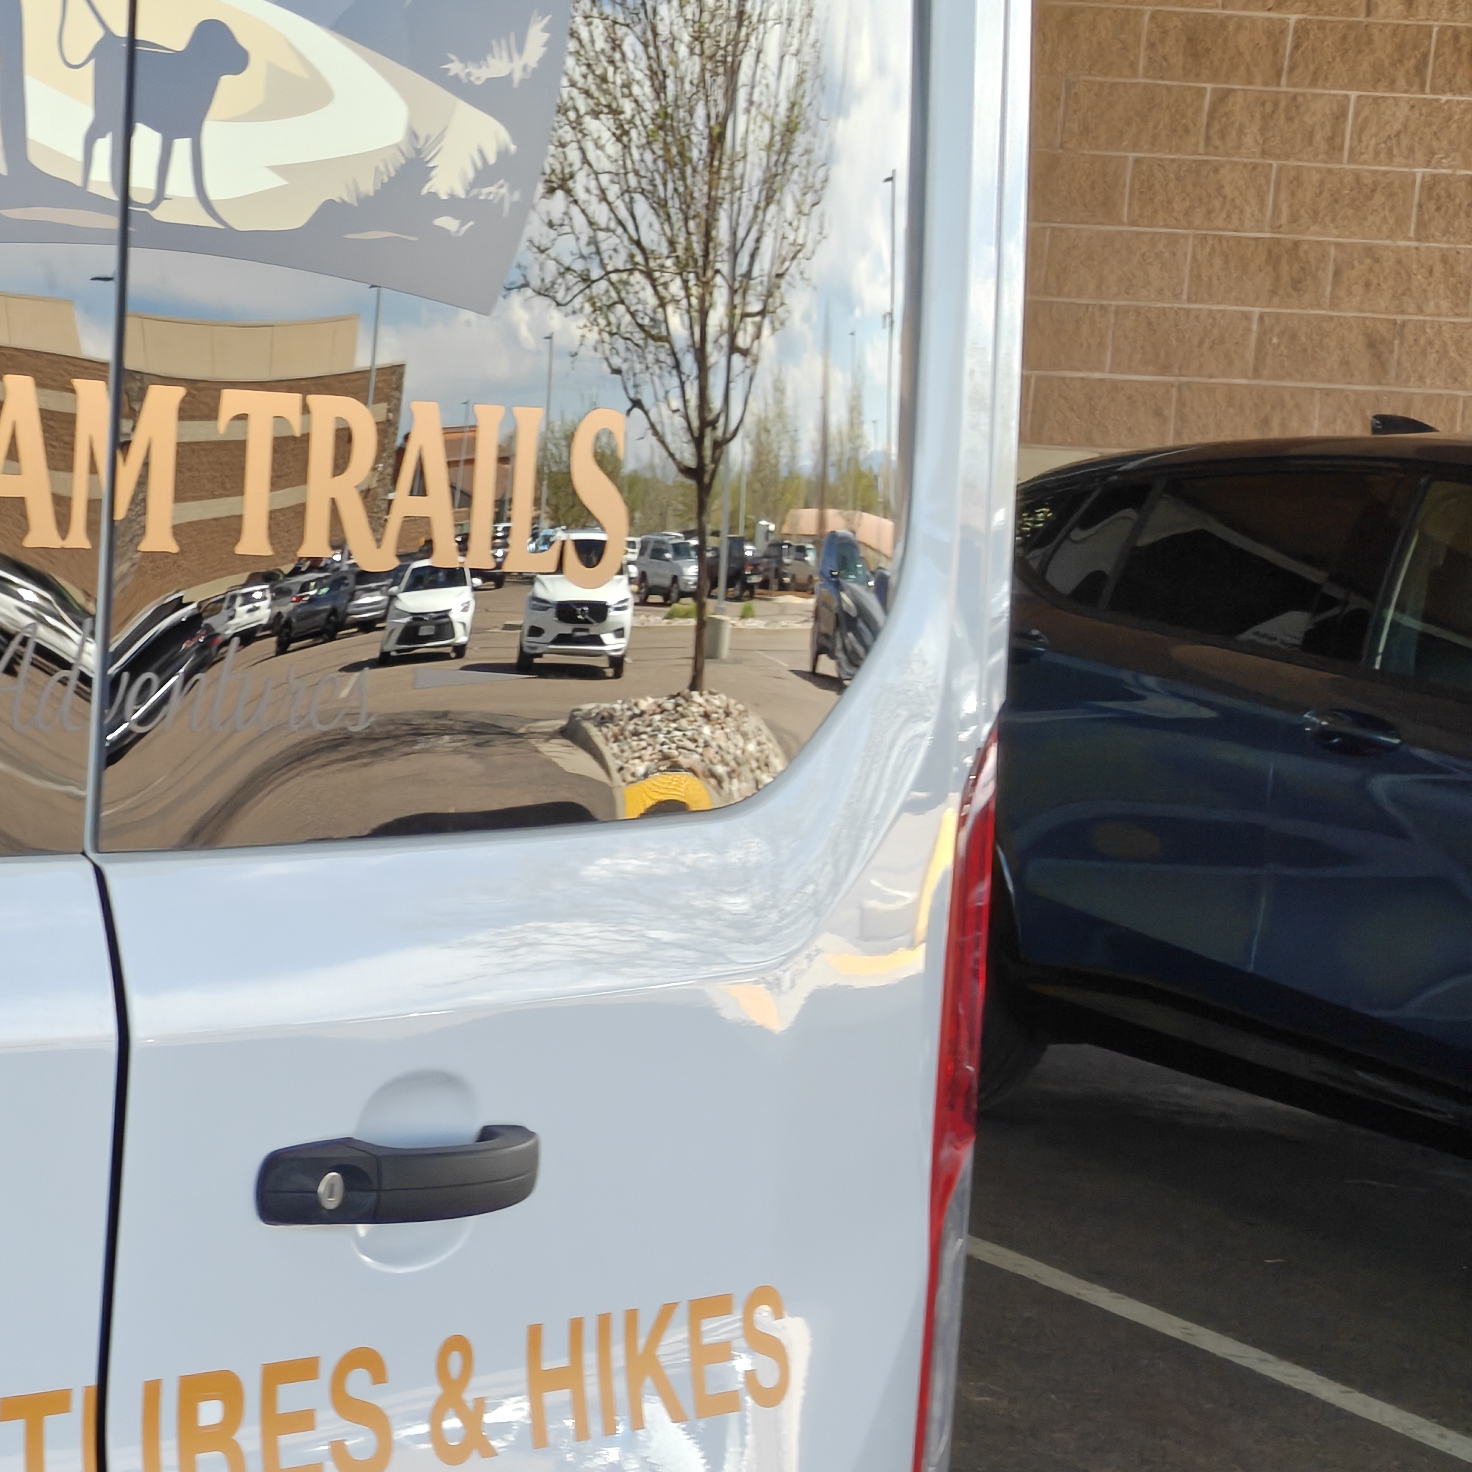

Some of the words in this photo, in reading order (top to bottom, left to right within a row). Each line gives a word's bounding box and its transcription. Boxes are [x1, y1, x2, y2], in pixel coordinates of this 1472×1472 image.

[218, 388, 630, 589] TRAILS
[429, 1334, 497, 1466] &
[525, 1285, 790, 1450] HIKES
